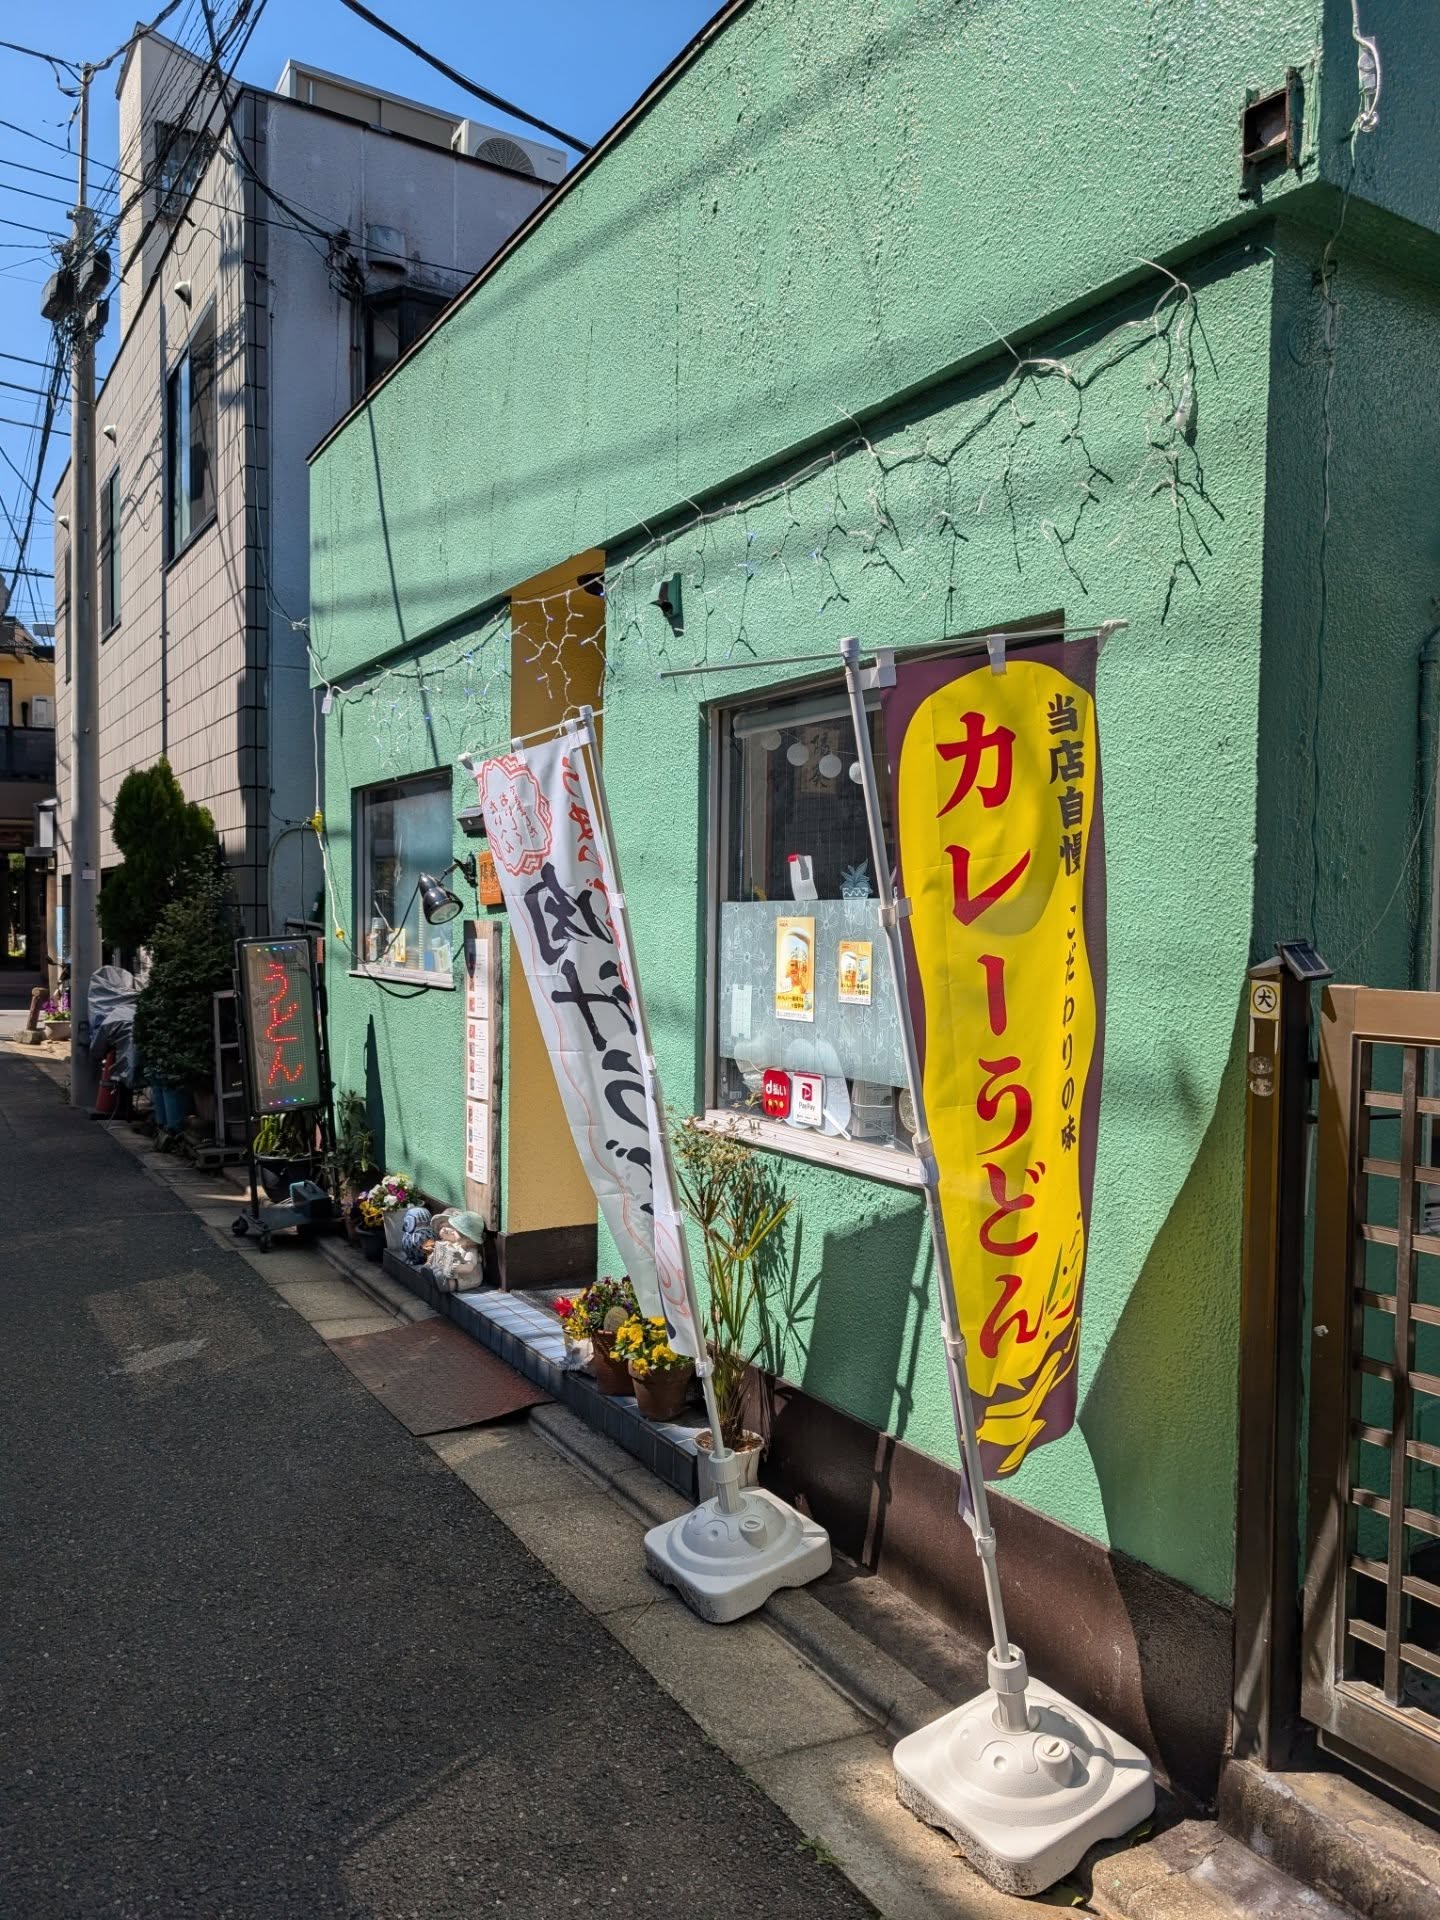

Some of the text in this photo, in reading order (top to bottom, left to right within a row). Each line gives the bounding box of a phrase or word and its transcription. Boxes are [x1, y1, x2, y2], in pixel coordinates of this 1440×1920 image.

[1047, 693, 1086, 877] 当店自慢
[935, 710, 1047, 1360] カレーうどん
[1060, 905, 1079, 1152] こだわりの味
[1257, 988, 1273, 1009] 犬
[765, 1079, 787, 1097] d払い
[798, 1101, 816, 1113] PayPay
